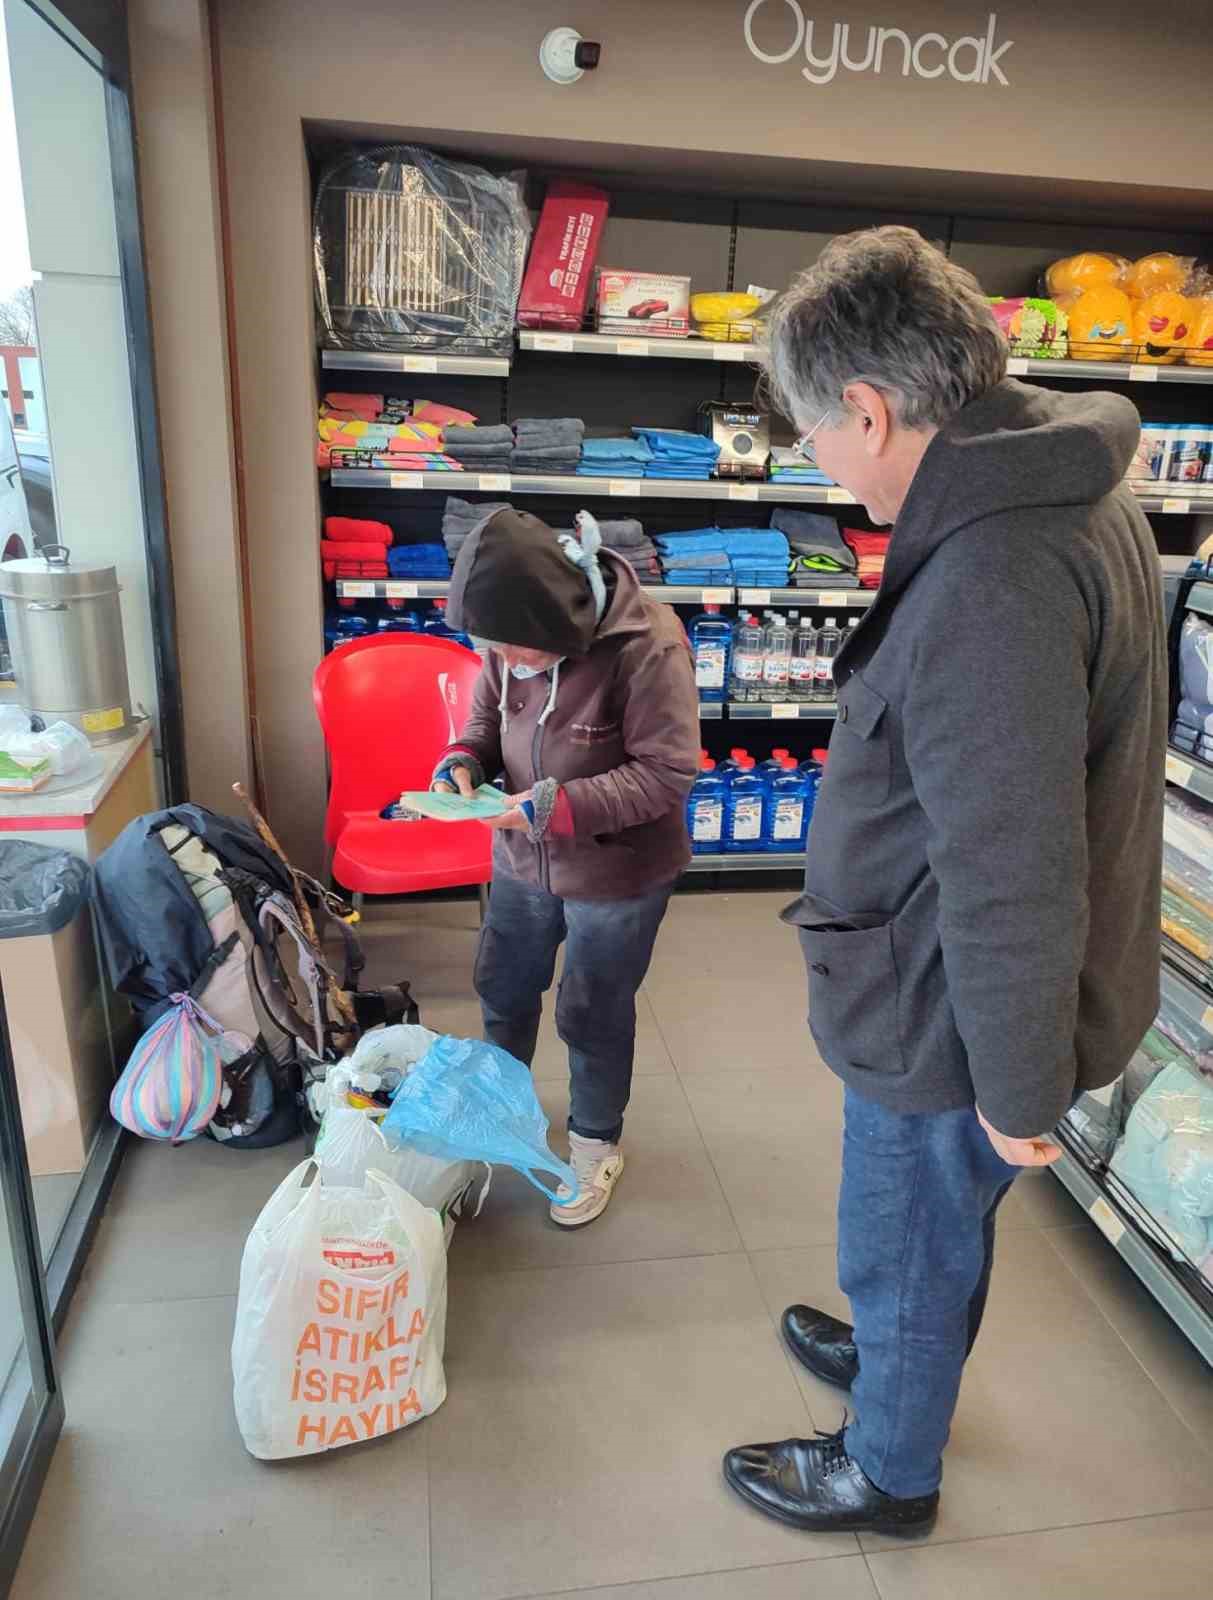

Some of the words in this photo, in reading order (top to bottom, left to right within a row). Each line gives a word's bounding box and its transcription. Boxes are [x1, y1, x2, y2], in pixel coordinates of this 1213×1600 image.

[743, 0, 1015, 86] Oyuncak
[317, 1270, 410, 1321] SIFIR
[295, 1308, 426, 1364] ATIKLA
[290, 1356, 424, 1403] İSRAF
[296, 1386, 422, 1447] HAYIR
